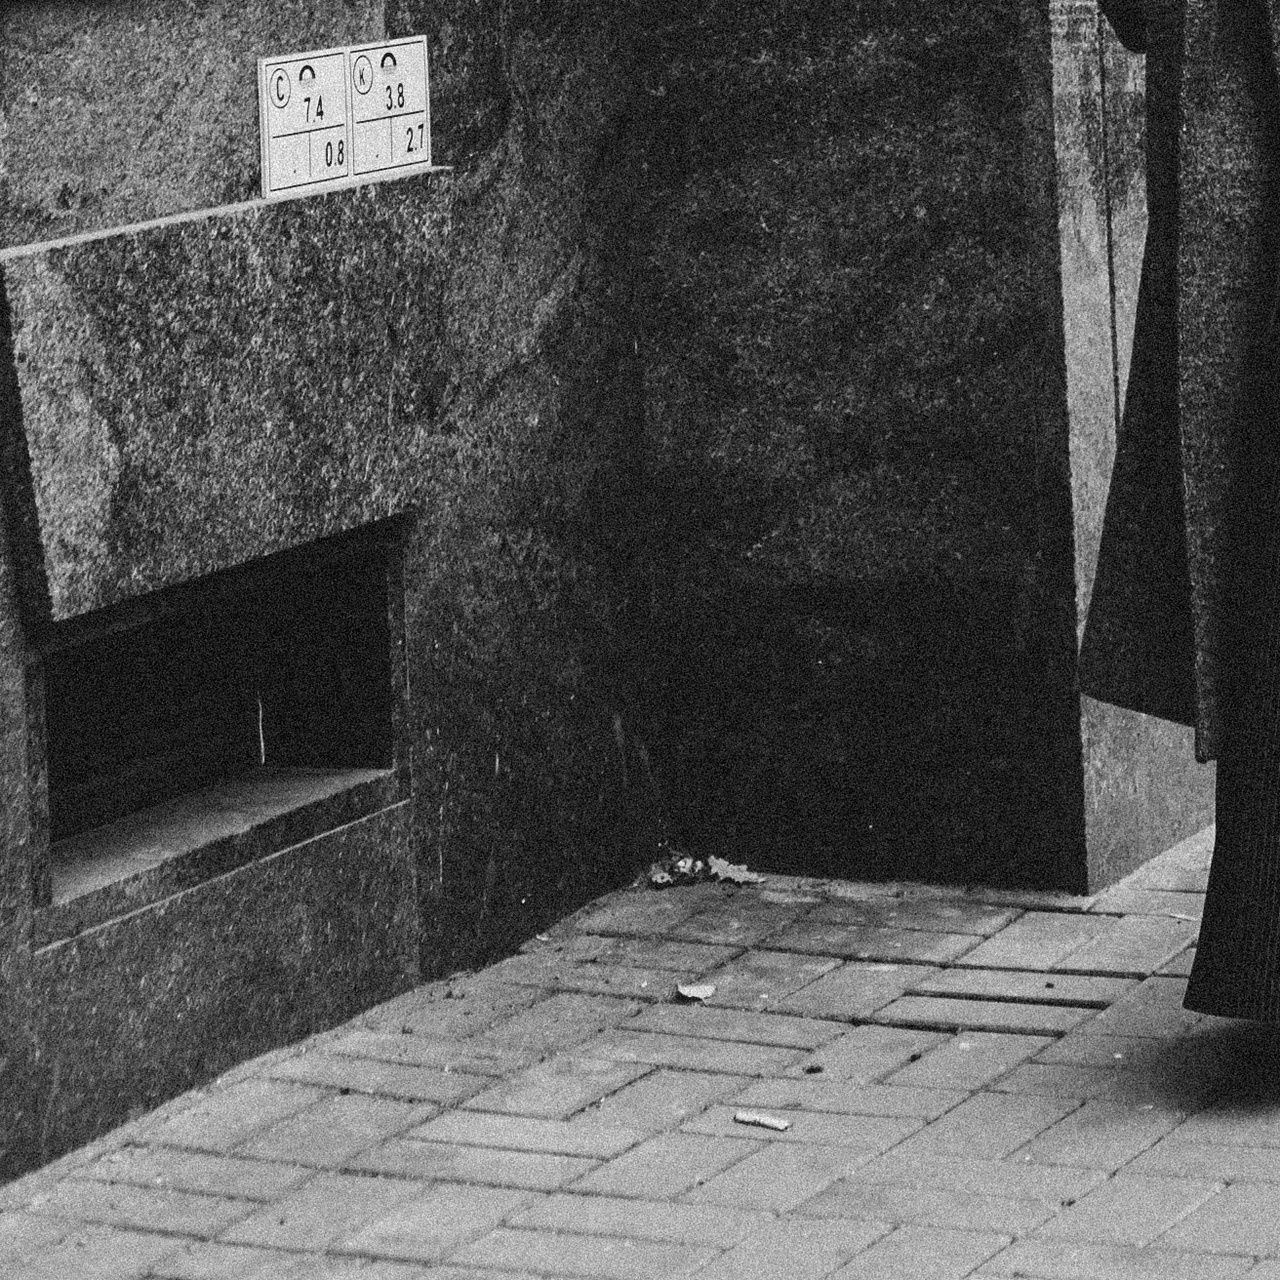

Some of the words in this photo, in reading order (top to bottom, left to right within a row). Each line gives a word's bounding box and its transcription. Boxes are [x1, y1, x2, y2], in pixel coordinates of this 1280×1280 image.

[304, 95, 324, 123] 7.4
[386, 82, 405, 111] 3.8
[406, 123, 424, 153] 2.7
[325, 139, 345, 167] 0.8
